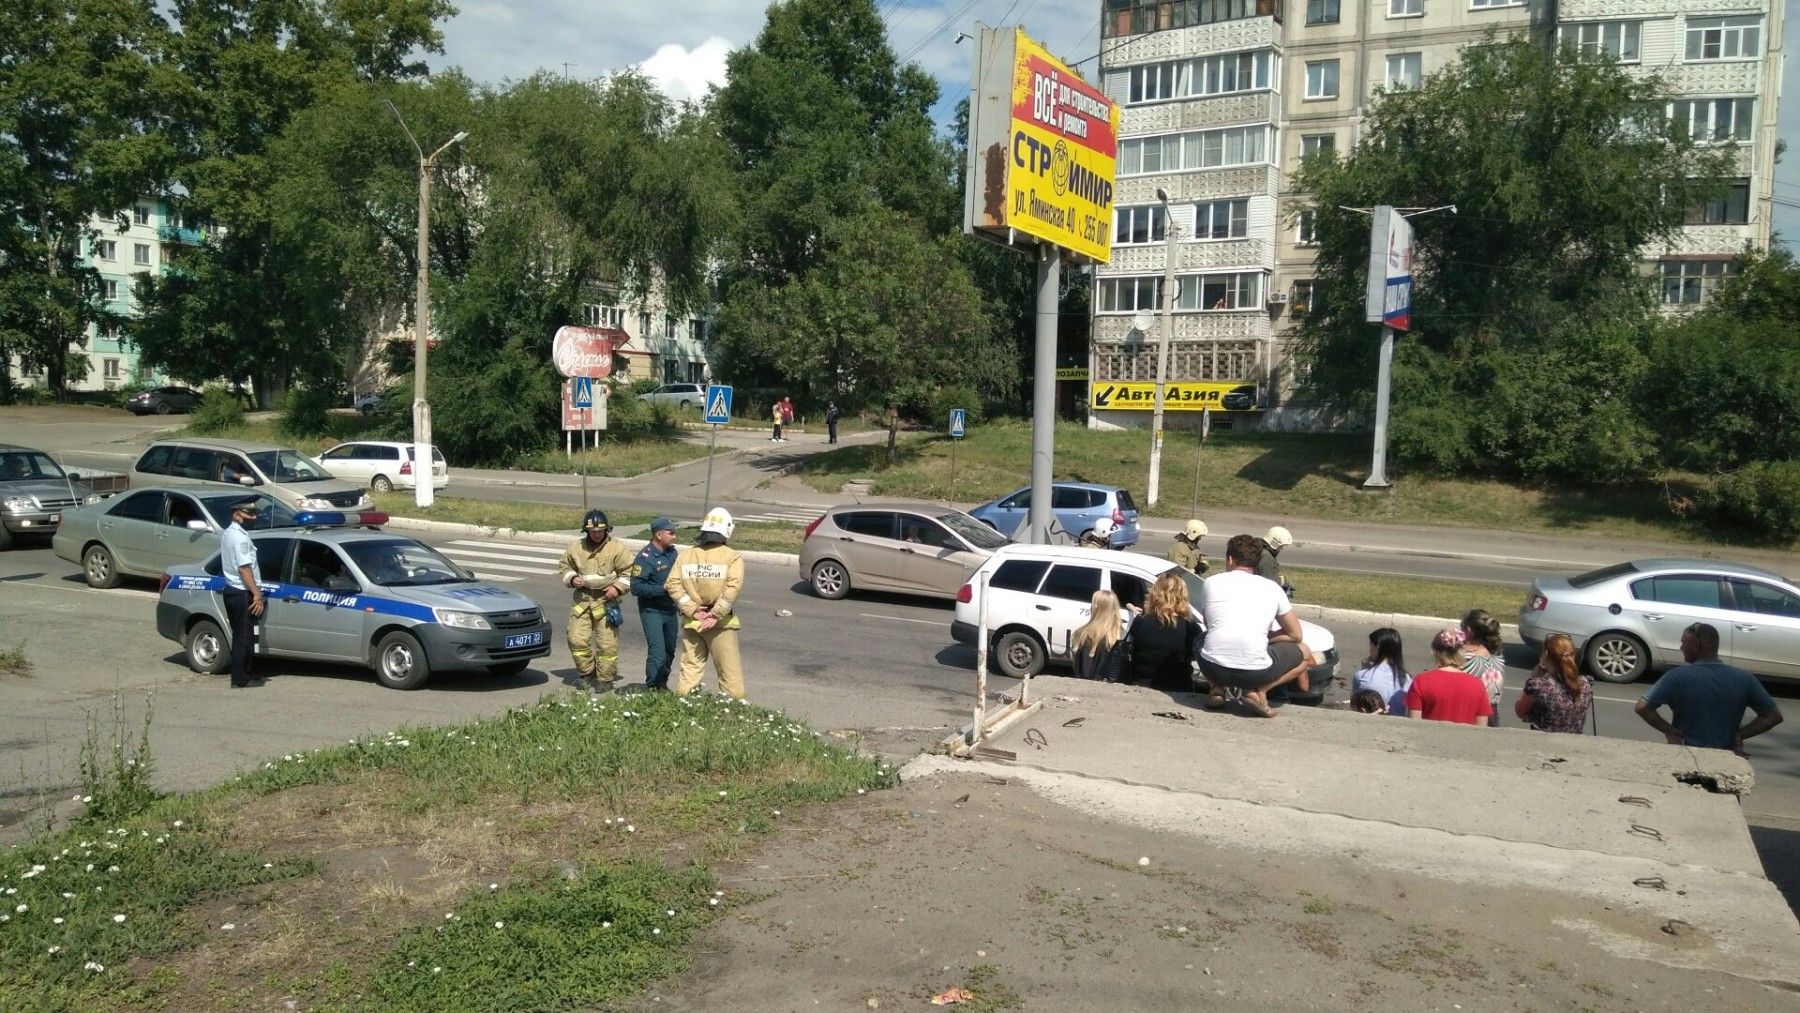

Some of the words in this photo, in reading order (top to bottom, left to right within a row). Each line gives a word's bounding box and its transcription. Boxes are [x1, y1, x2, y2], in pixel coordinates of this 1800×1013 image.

[1034, 71, 1057, 126] ВСЁ
[1058, 110, 1063, 129] и
[1014, 189, 1026, 216] ул.
[303, 590, 357, 607] ПОЛИЦИЯ
